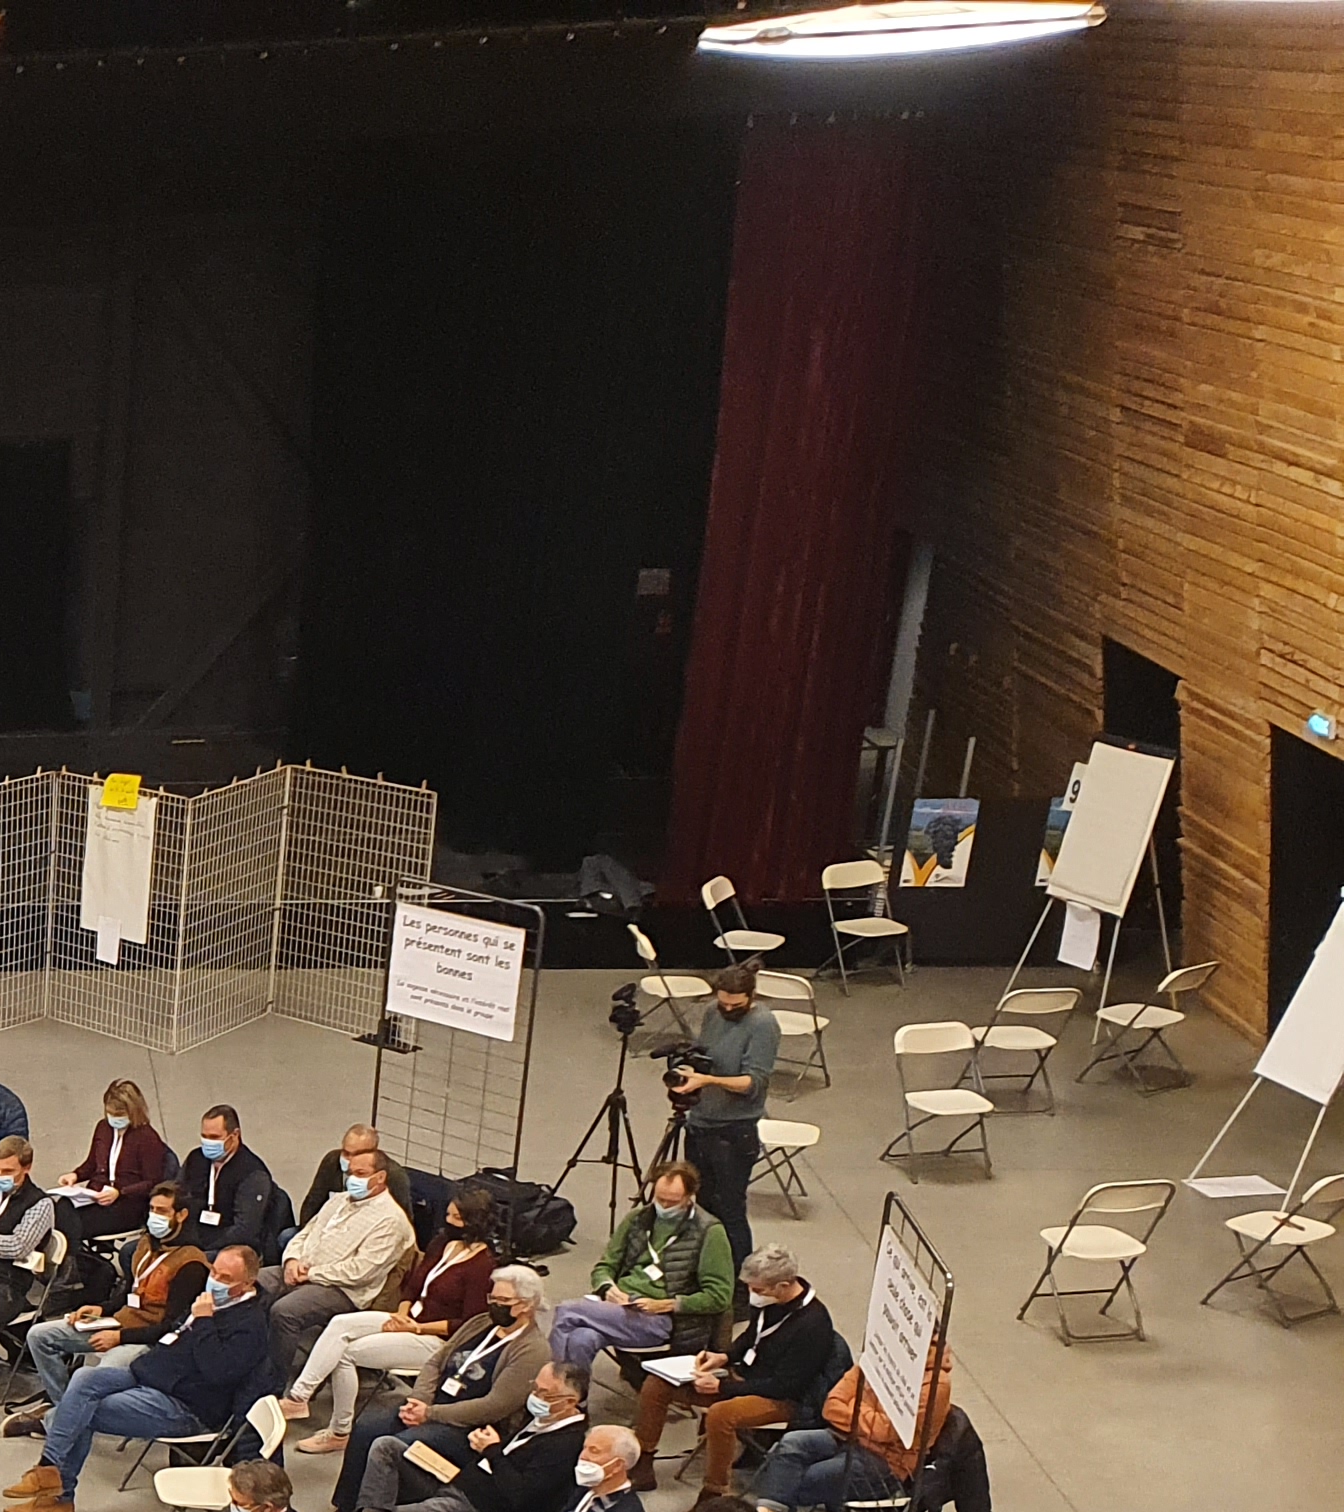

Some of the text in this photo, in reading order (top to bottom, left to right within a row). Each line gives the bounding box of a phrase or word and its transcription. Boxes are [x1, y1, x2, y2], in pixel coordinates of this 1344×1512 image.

[1069, 779, 1081, 803] 9
[402, 915, 516, 951] Les personnes qui se
[404, 937, 511, 970] présentent sont les
[436, 962, 472, 981] bonnes
